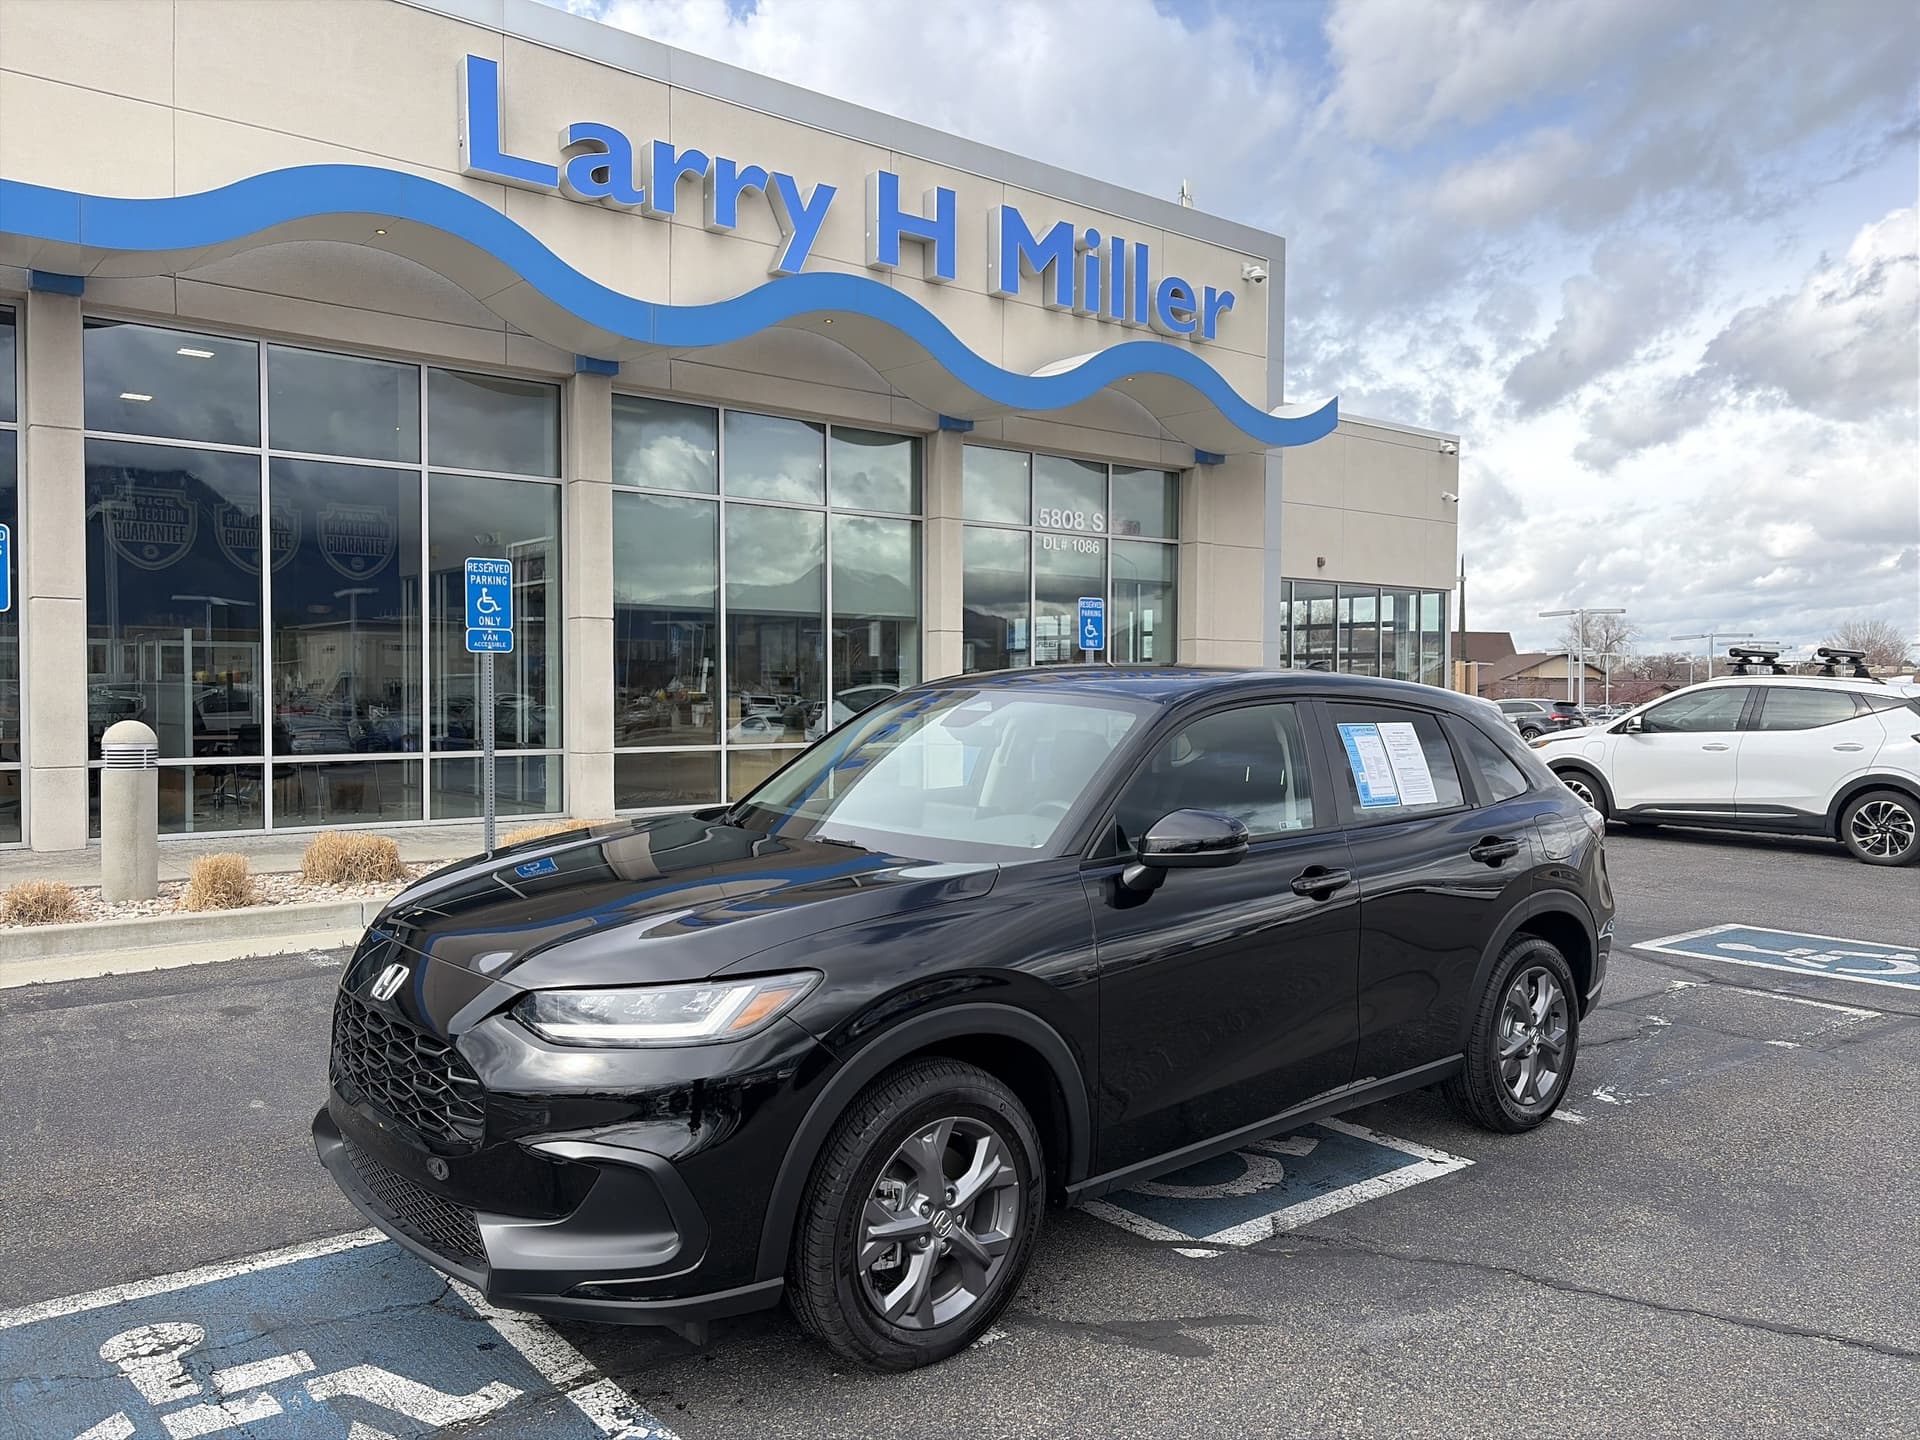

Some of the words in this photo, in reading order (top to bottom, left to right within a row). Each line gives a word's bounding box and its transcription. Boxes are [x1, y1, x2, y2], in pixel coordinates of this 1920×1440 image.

[465, 53, 836, 275] Larry
[875, 170, 956, 282] H
[999, 204, 1236, 341] Miller
[226, 510, 288, 531] PROTEION
[1039, 508, 1085, 530] 5808
[1092, 513, 1104, 532] S
[114, 521, 186, 543] GUARANTEE
[225, 529, 291, 549] GUARTEE
[326, 535, 388, 556] GUARANTEE
[1043, 537, 1067, 551] DL#
[1072, 539, 1100, 554] 1086
[467, 562, 510, 574] RESERVED
[470, 575, 507, 586] PARKING
[1080, 600, 1103, 609] RESERVED
[1081, 609, 1102, 617] PARKING
[478, 616, 501, 626] ONLY
[482, 633, 499, 642] VAN
[1085, 639, 1098, 647] ONLY
